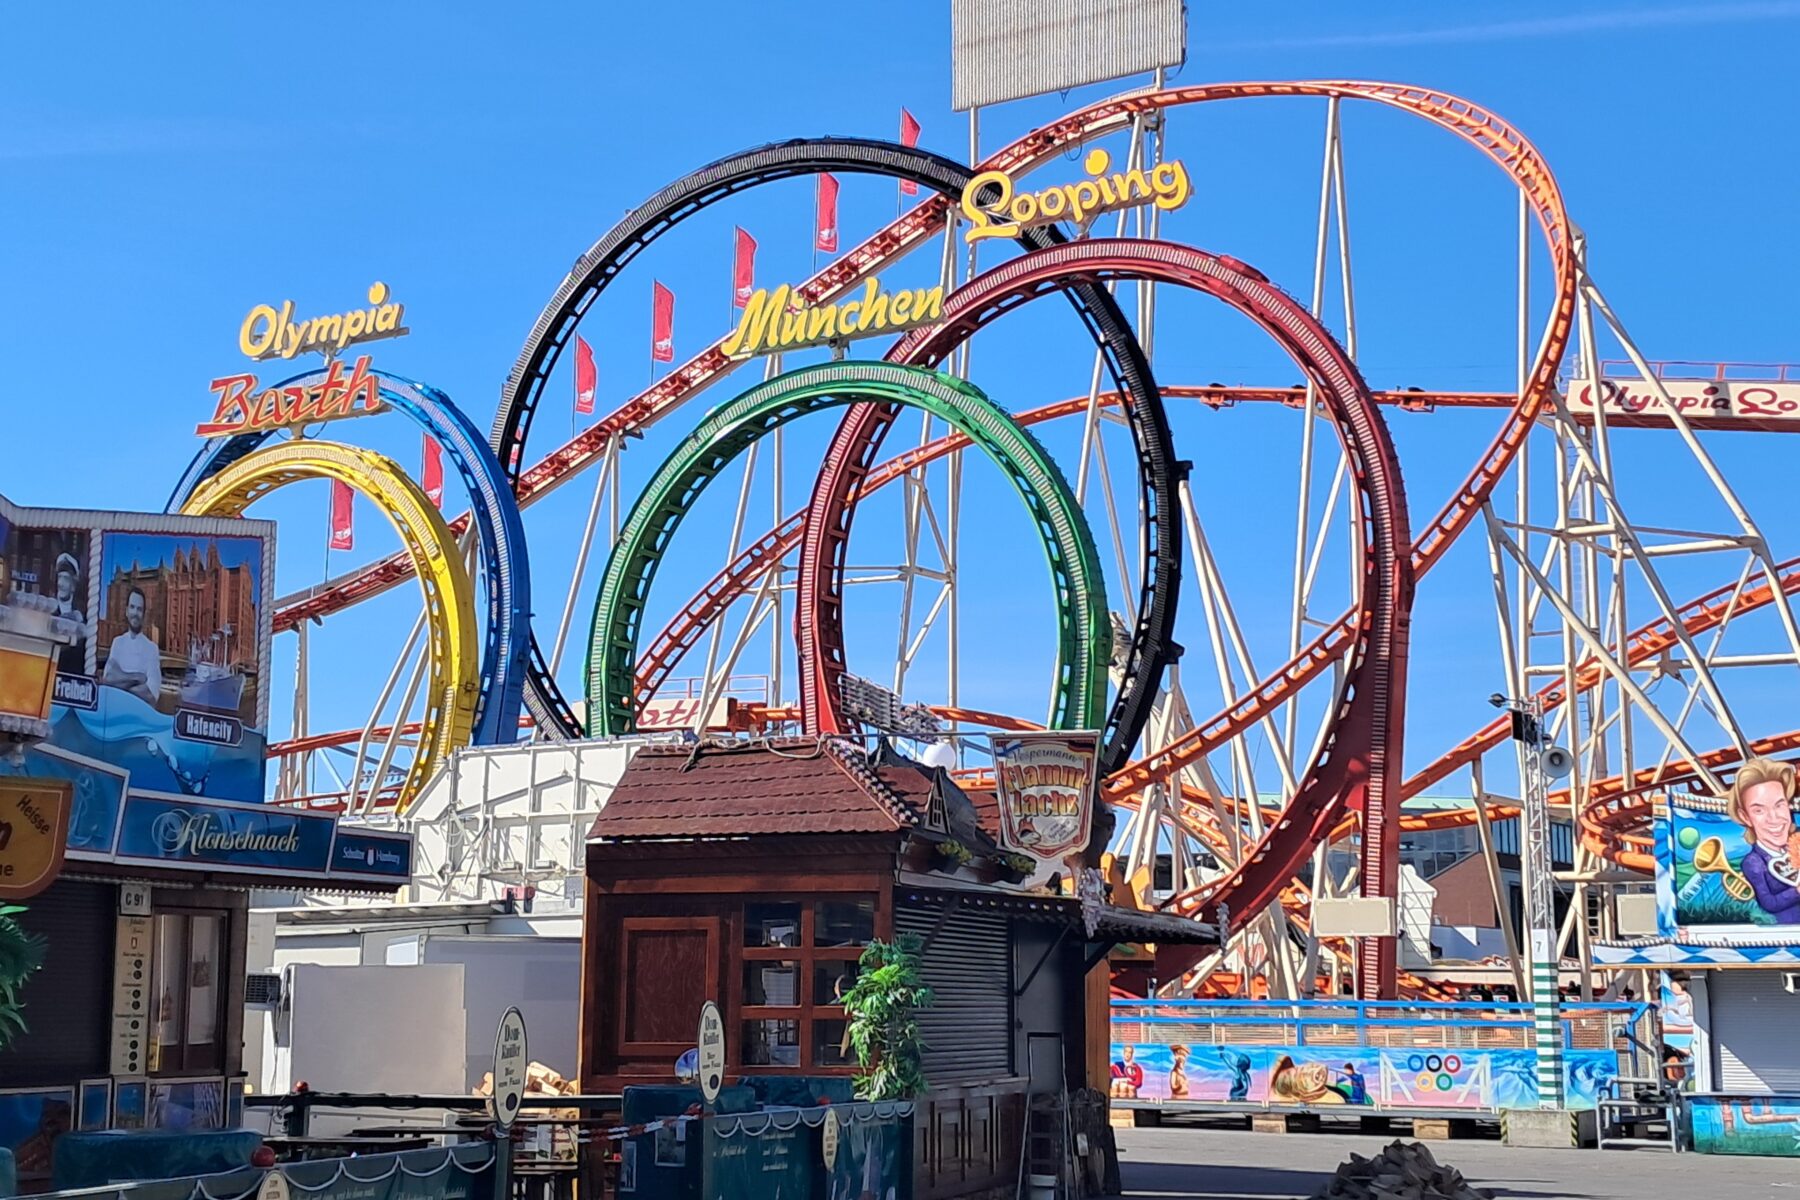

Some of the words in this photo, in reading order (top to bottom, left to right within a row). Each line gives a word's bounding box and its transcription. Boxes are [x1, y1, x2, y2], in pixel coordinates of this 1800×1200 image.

[961, 149, 1191, 244] Looping
[239, 281, 402, 359] Olympia
[721, 277, 946, 357] München
[195, 355, 380, 437] Barth
[186, 714, 233, 742] Hafencity
[16, 794, 51, 836] Heisse
[152, 808, 300, 857] Klönschnack
[125, 892, 132, 906] C
[134, 893, 144, 906] 91
[1535, 941, 1542, 953] 7
